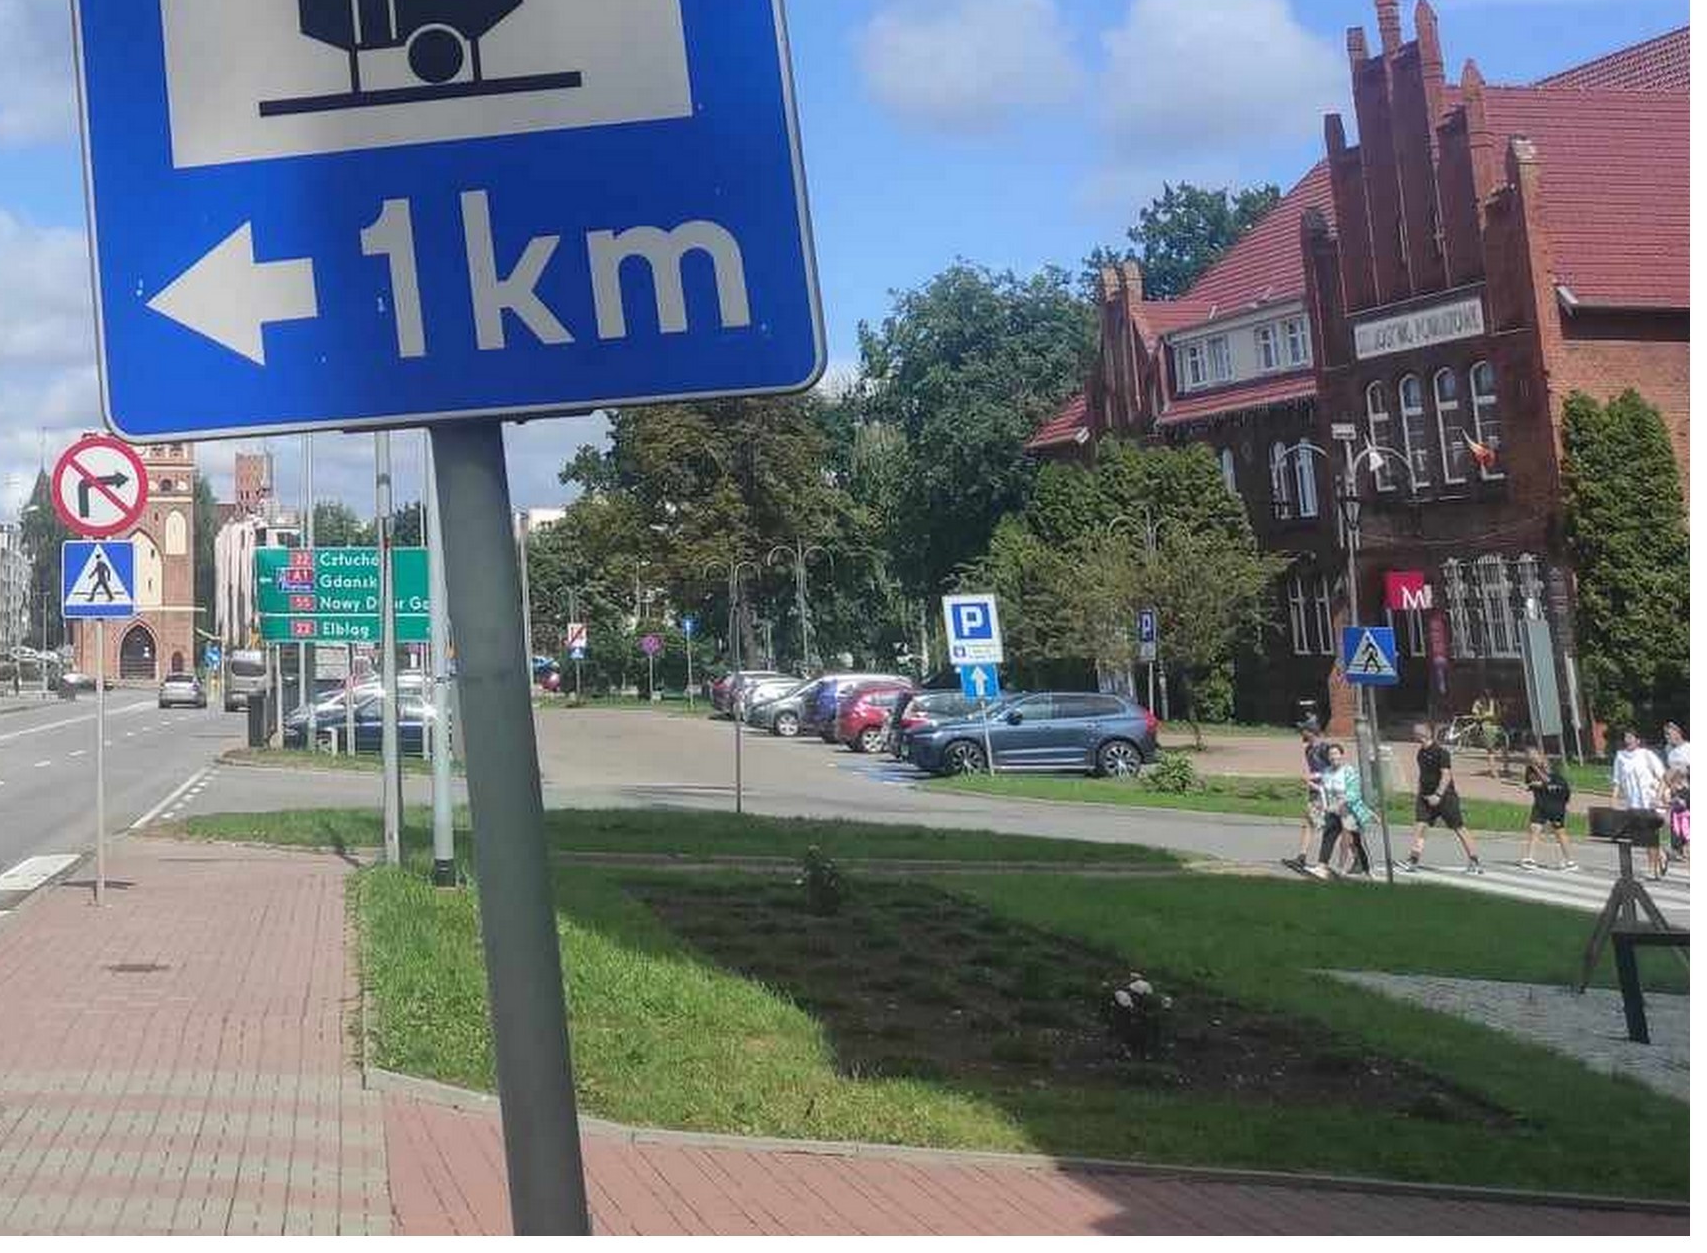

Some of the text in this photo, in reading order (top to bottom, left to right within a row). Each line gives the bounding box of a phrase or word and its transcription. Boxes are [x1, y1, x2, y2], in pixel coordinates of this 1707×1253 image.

[319, 596, 360, 612] Nowy
[960, 606, 983, 636] P
[1141, 613, 1151, 639] P
